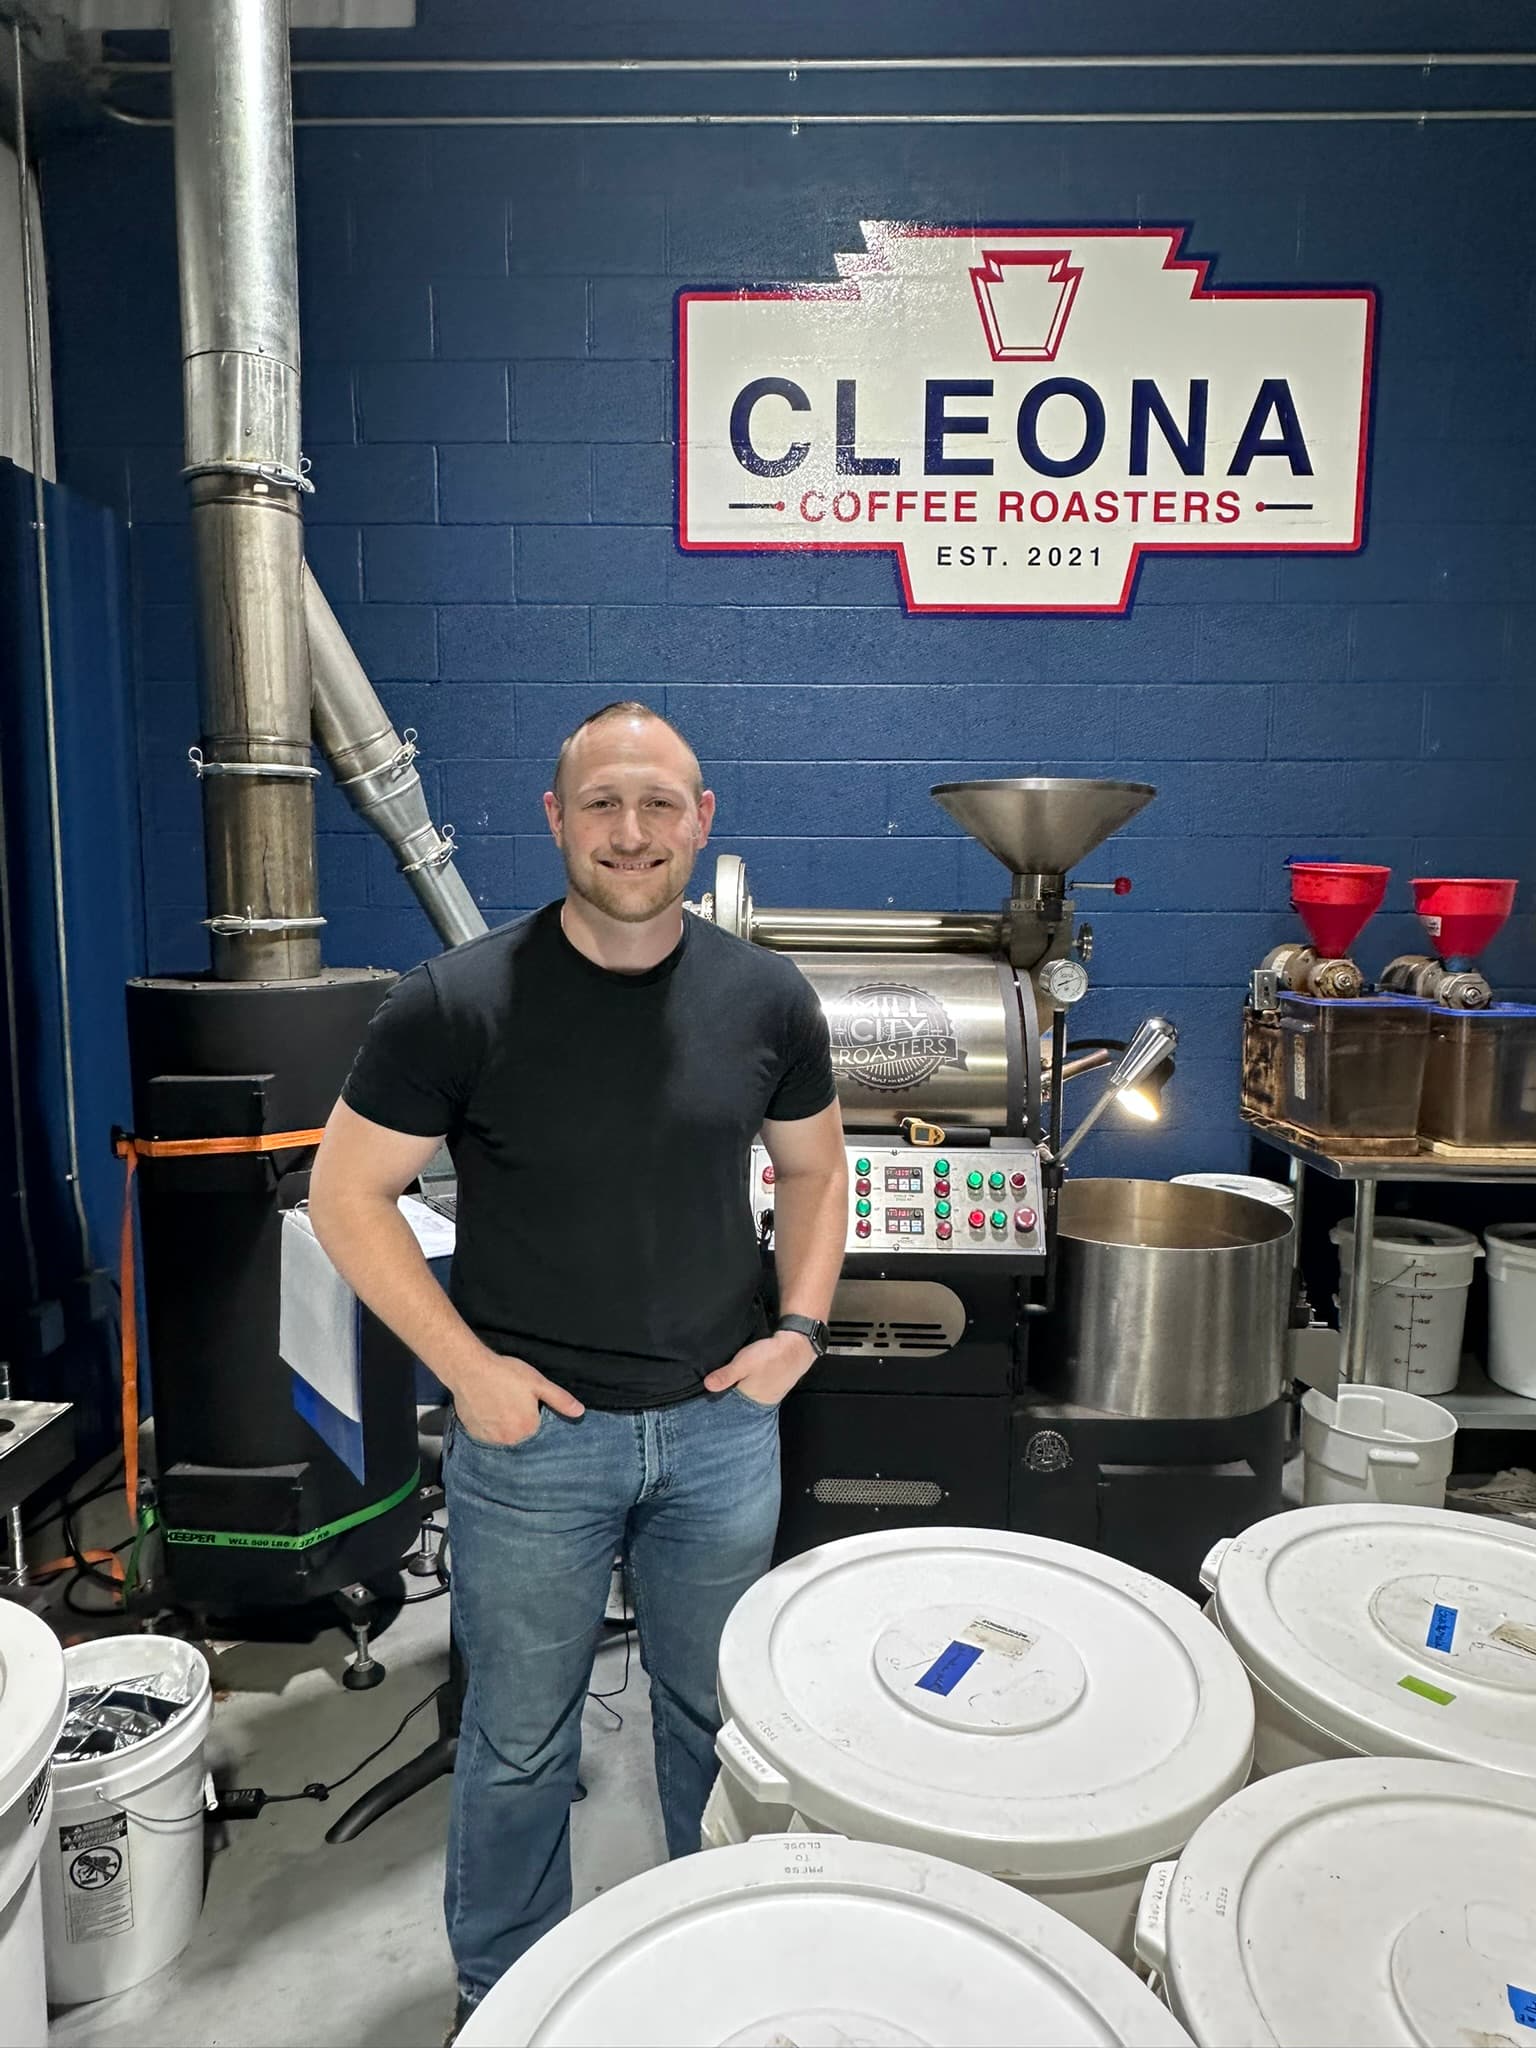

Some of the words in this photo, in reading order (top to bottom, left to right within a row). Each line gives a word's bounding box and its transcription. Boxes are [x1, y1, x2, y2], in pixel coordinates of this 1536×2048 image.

[729, 376, 1314, 479] CLEONA
[800, 490, 977, 525] COFFEE
[999, 490, 1241, 525] ROASTERS
[937, 546, 1009, 568] EST.
[1028, 546, 1103, 568] 2021
[852, 995, 927, 1018] MILL
[850, 1017, 928, 1043] CITY
[839, 1038, 948, 1066] ROASTERS
[167, 1531, 216, 1544] KEEPER
